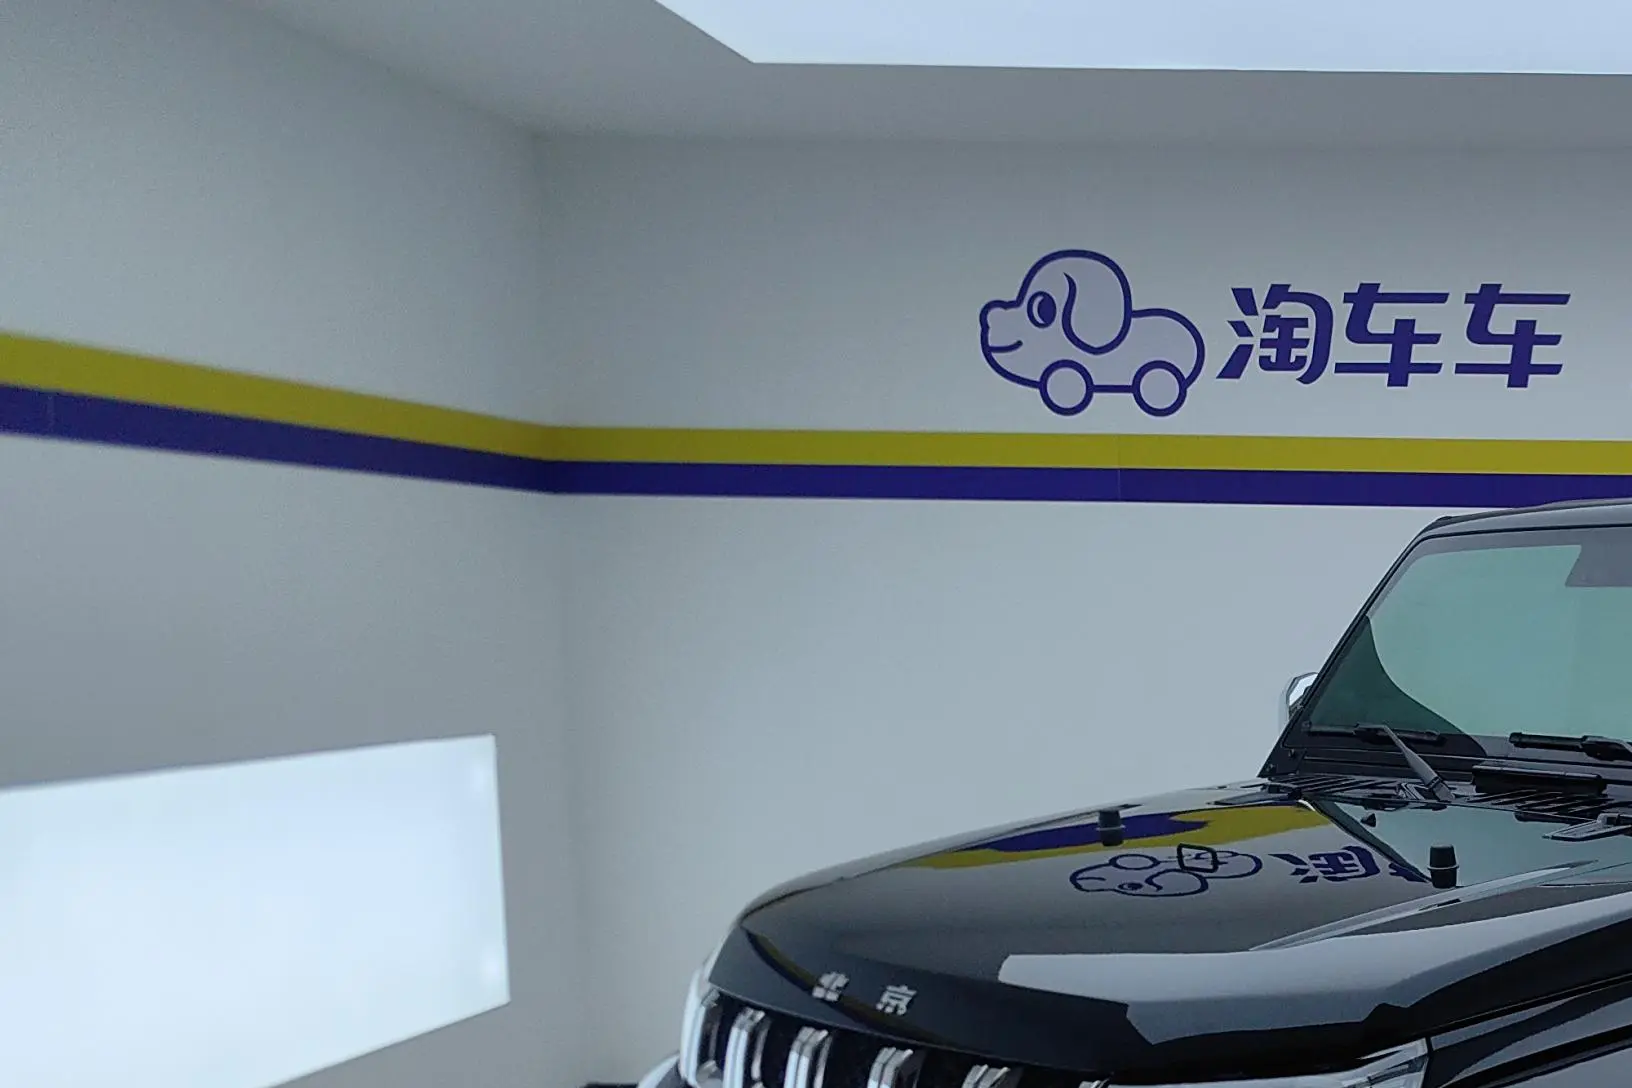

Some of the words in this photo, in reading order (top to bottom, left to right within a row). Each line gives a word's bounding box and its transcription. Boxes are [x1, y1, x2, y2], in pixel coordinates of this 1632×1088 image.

[1215, 282, 1572, 389] 淘车车
[812, 971, 917, 1016] 北京
